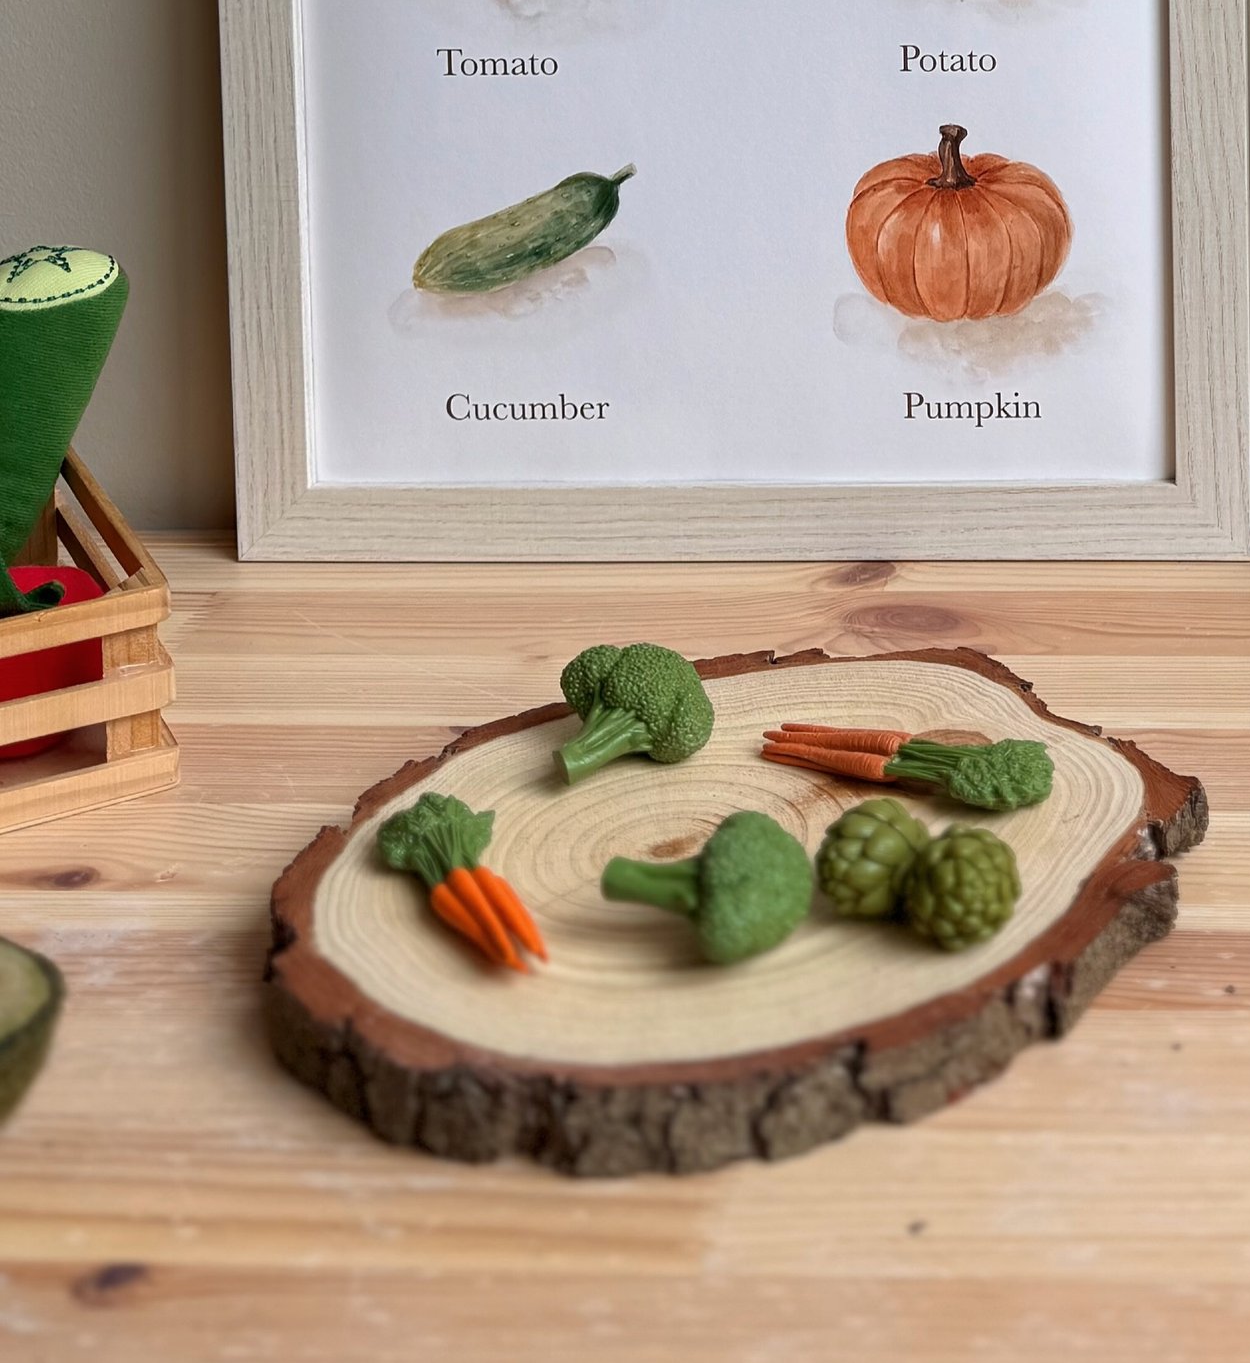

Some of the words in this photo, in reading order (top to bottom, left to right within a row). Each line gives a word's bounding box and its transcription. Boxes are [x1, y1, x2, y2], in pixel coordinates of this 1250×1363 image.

[437, 49, 560, 78] Tomato
[900, 45, 998, 74] Potato
[446, 394, 611, 422] Cucumber
[904, 392, 1043, 429] Pumpkin
